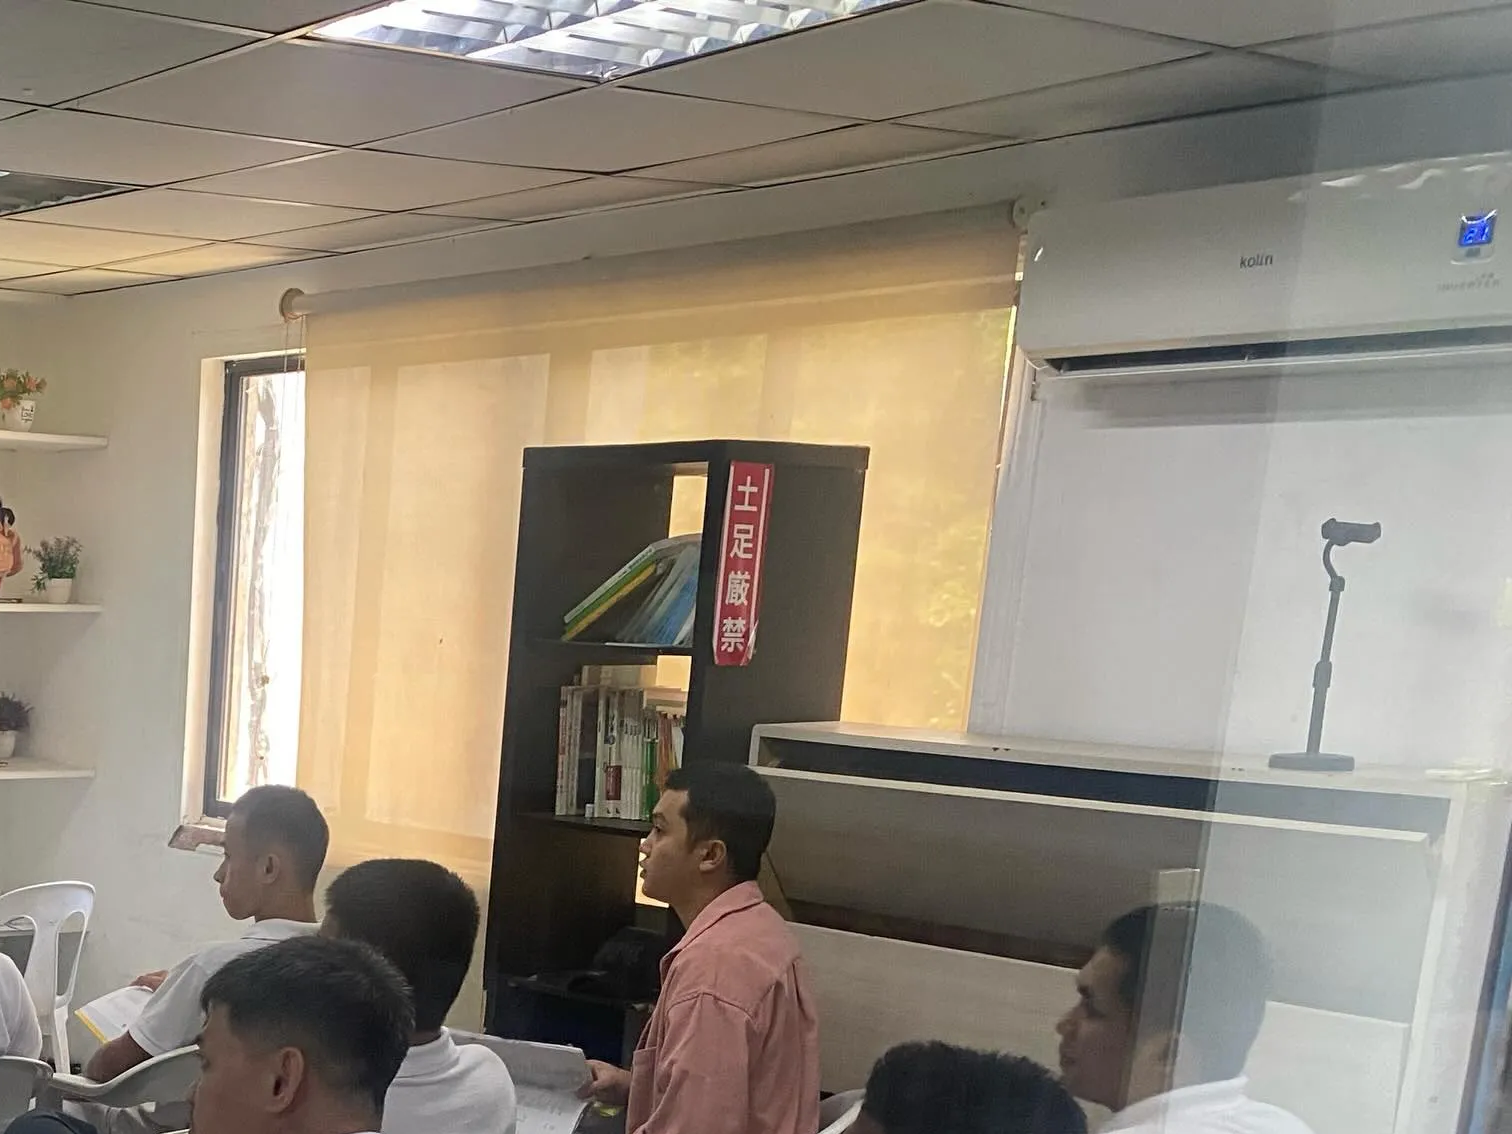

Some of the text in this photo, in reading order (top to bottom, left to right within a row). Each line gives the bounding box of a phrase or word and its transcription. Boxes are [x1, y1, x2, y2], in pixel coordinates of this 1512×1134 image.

[1239, 253, 1273, 268] kolin
[720, 475, 759, 653] 土足厳禁
